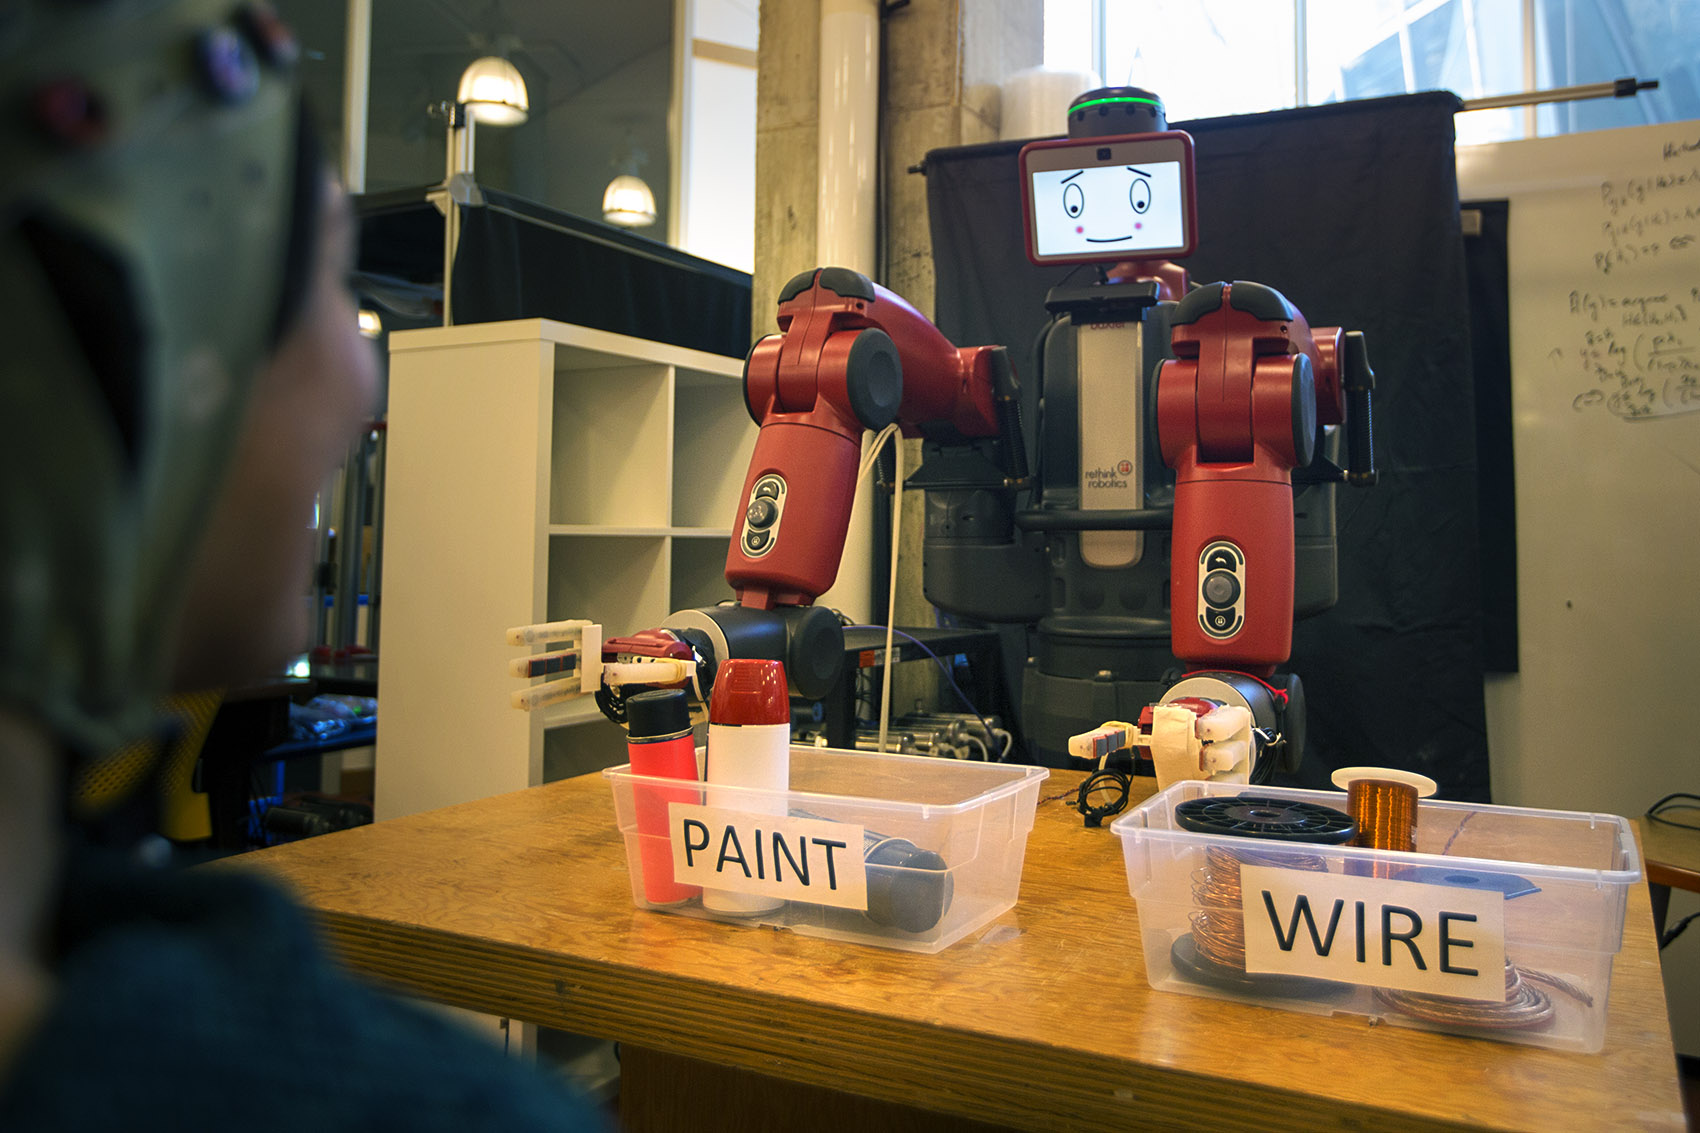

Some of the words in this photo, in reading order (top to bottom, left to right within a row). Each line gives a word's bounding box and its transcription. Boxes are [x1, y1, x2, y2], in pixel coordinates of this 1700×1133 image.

[1085, 467, 1117, 479] rethink
[1088, 479, 1128, 488] robotics
[683, 818, 847, 890] PAINT
[1262, 889, 1479, 976] WIRE
